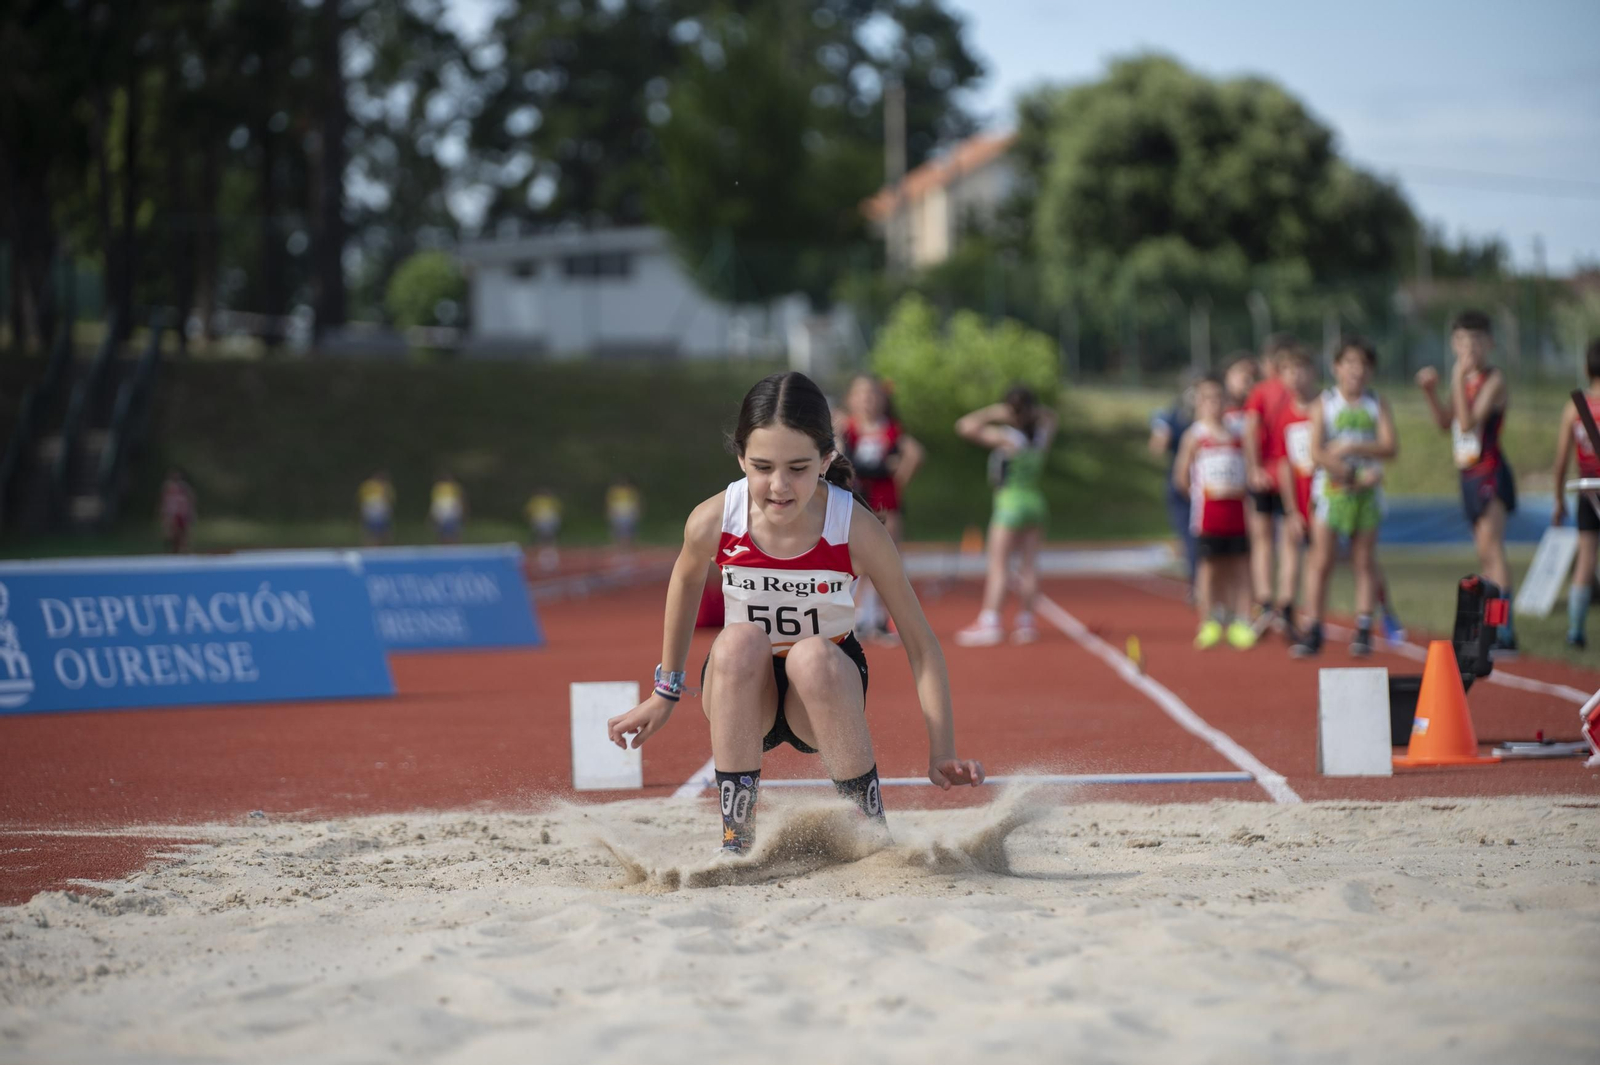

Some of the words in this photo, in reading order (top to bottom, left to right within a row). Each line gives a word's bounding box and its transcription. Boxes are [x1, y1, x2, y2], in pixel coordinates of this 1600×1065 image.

[366, 566, 502, 606] PUTACIÓN
[726, 572, 756, 591] La
[761, 576, 843, 597] Región
[39, 581, 315, 638] DEPUTACIÓN
[747, 605, 820, 636] 561
[53, 641, 260, 690] OURENSE
